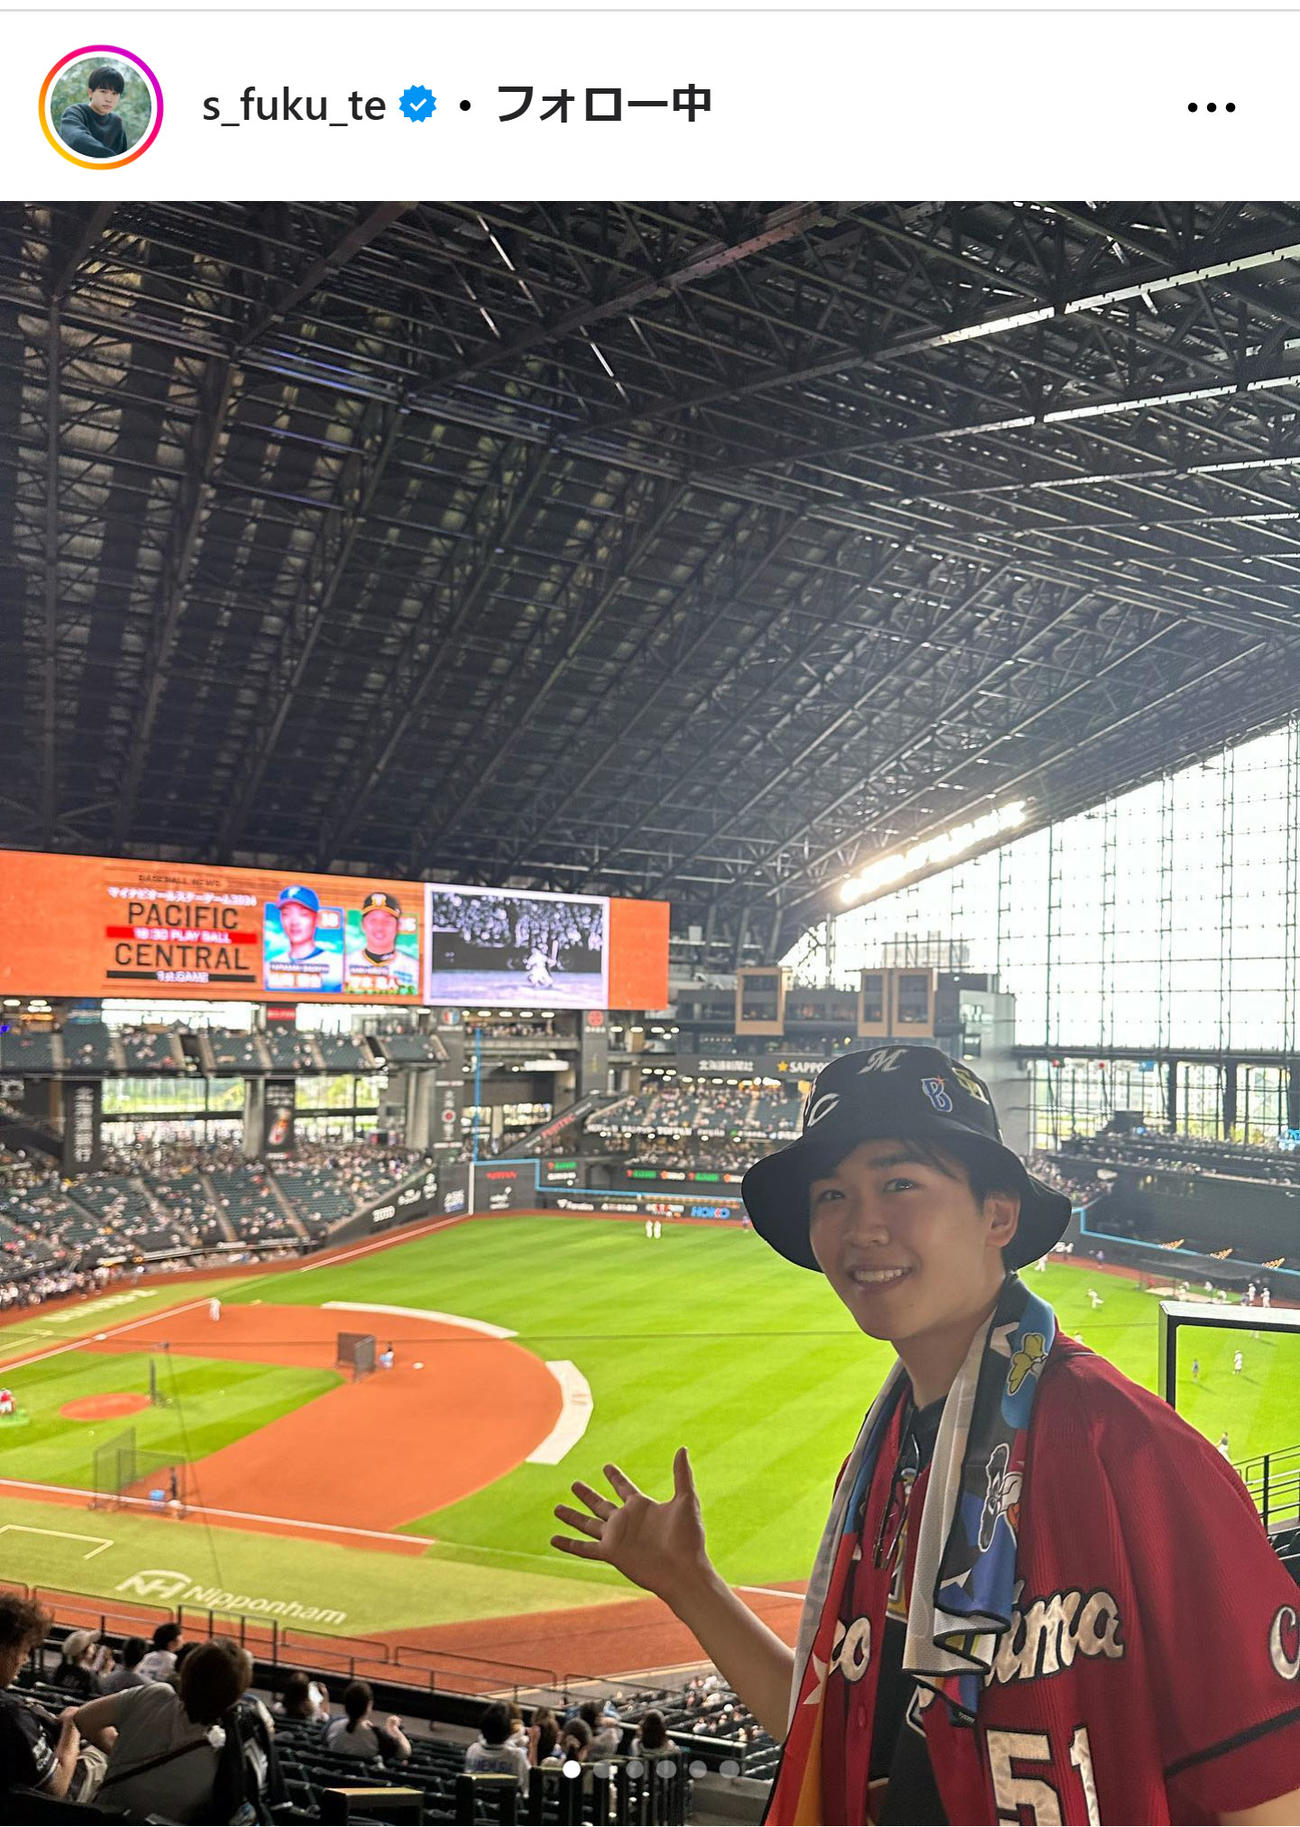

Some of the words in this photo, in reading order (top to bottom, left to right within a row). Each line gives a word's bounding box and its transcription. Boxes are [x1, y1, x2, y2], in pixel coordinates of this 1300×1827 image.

[128, 902, 238, 929] PACIFIC
[170, 928, 200, 942] PLAY
[202, 930, 231, 944] BALL
[115, 942, 250, 970] CENTRAL
[181, 1585, 348, 1625] Nipponham
[985, 1725, 1101, 1825] 51
